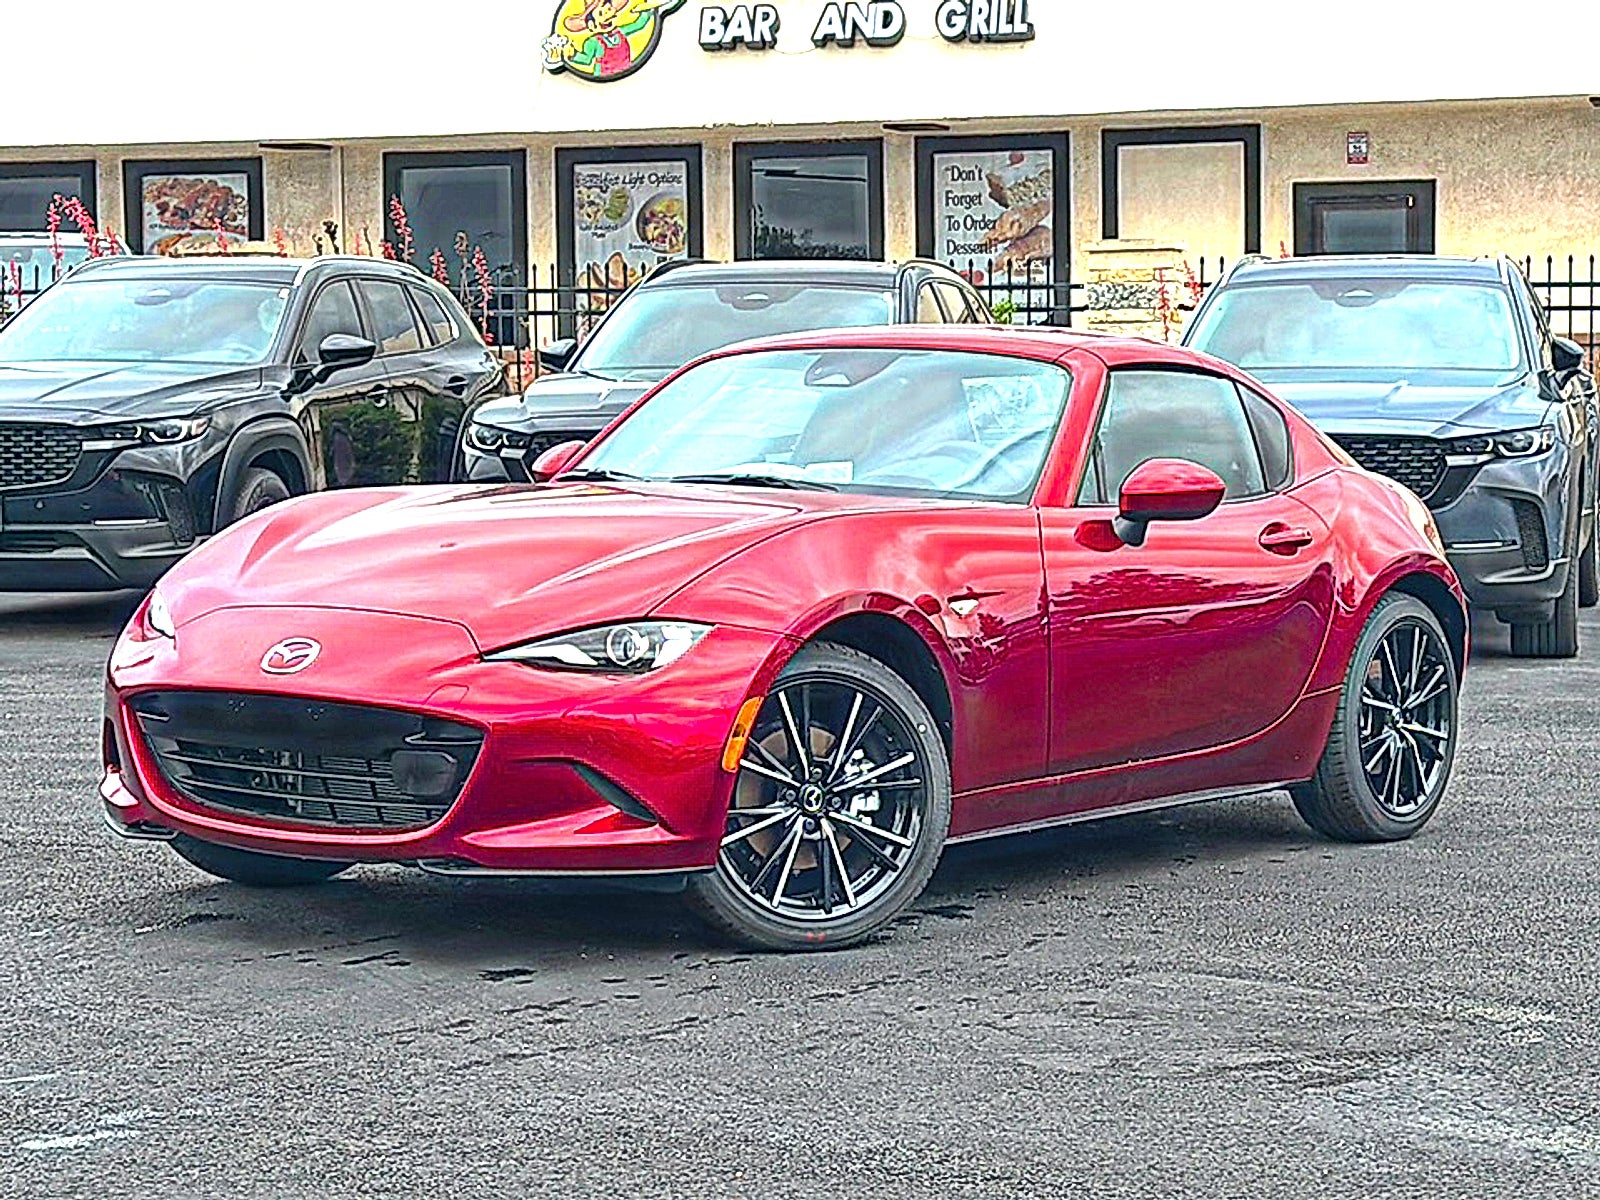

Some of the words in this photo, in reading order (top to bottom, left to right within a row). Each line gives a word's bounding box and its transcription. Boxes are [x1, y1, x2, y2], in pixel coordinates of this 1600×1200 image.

[699, 4, 779, 49] BAR
[811, 2, 905, 47] AND
[936, 0, 1035, 42] GRILL
[945, 190, 983, 210] Forget
[945, 215, 961, 231] To
